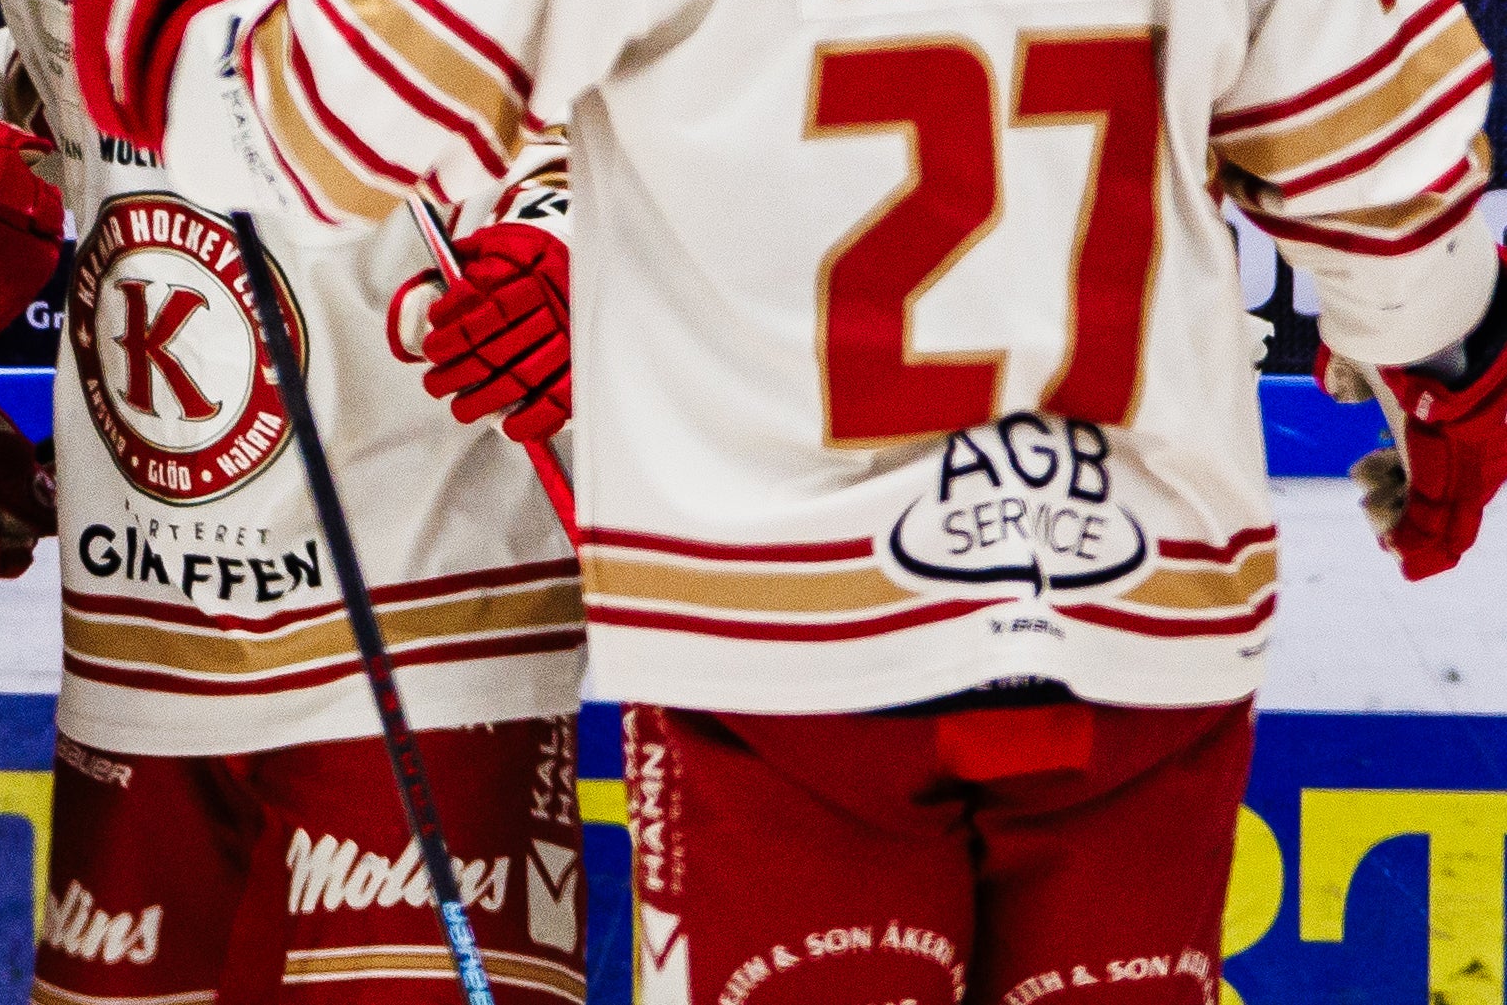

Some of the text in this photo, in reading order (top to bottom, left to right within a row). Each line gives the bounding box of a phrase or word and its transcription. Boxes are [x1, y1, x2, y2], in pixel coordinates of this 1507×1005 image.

[128, 208, 243, 273] HOCKEY
[800, 23, 1169, 449] 27
[111, 277, 223, 422] K
[147, 458, 193, 492] GLÖD
[215, 410, 284, 479] HJÄRTA
[938, 409, 1111, 503] AGB
[941, 497, 1107, 561] SERVICE
[285, 827, 510, 916] Molns
[803, 926, 875, 959] SON
[1105, 954, 1172, 984] SON
